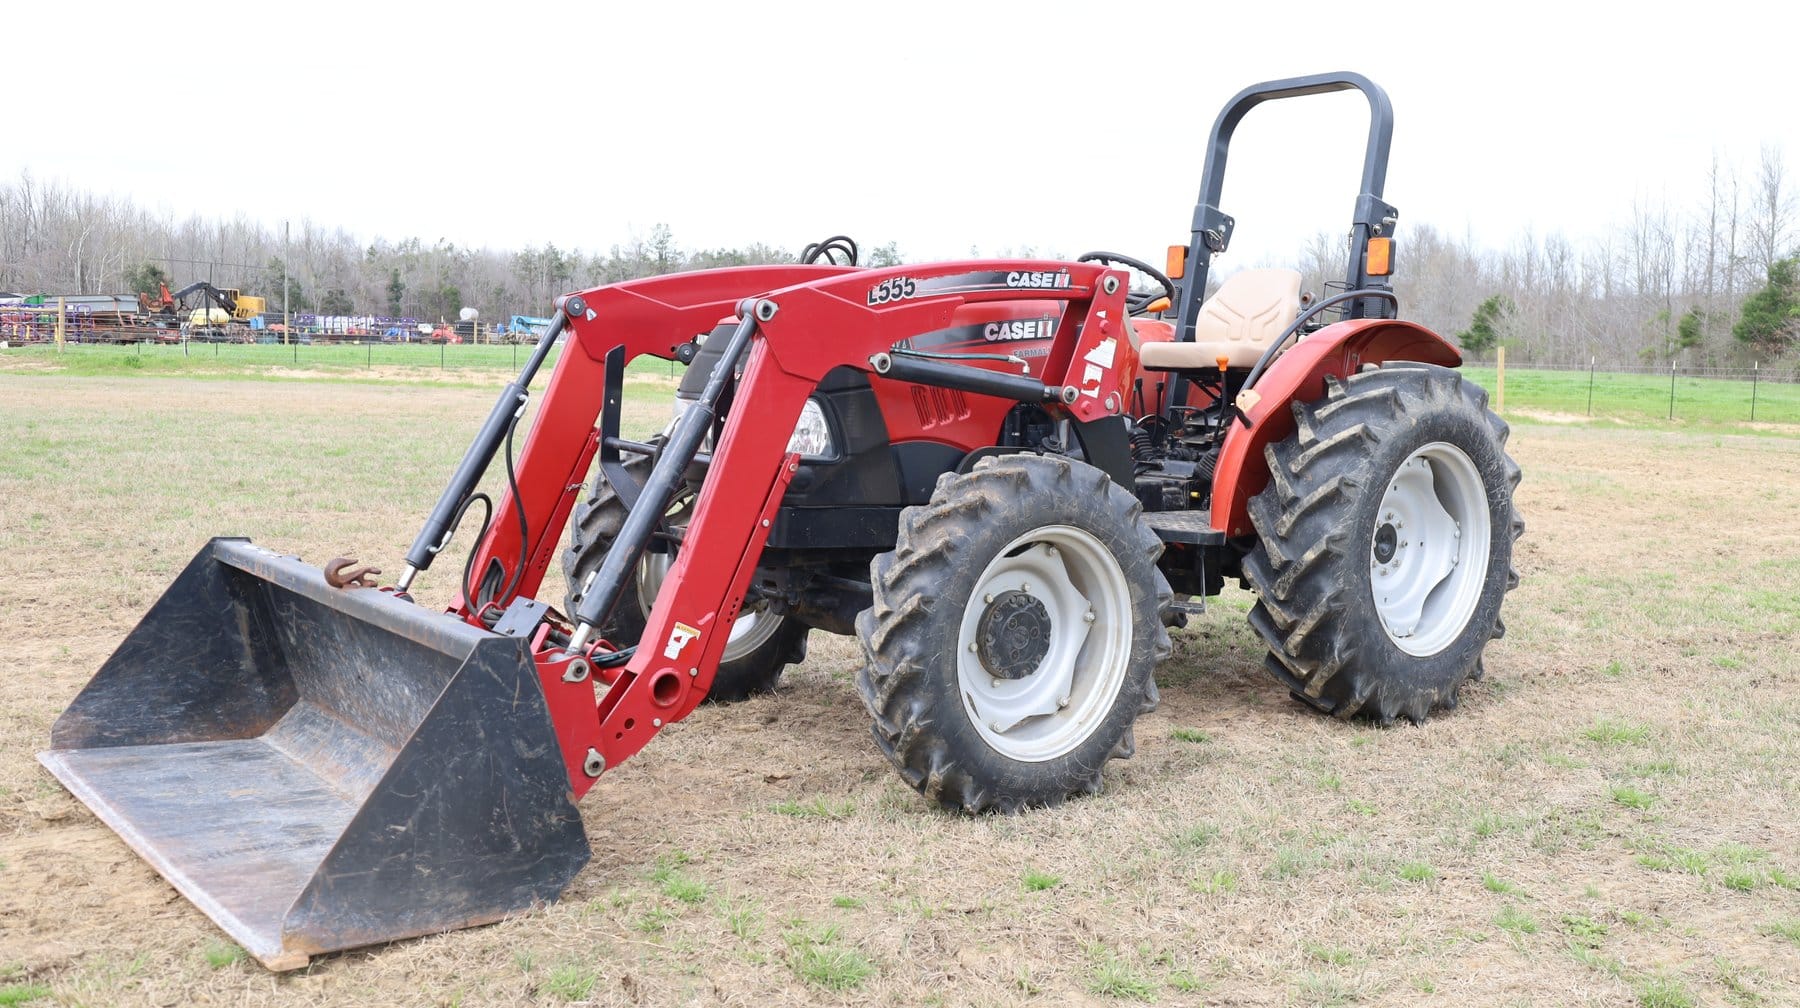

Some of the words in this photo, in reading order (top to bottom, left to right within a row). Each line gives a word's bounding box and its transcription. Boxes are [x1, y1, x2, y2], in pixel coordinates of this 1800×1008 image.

[1007, 271, 1054, 287] CASE
[868, 277, 916, 306] L555
[985, 321, 1037, 341] CASE
